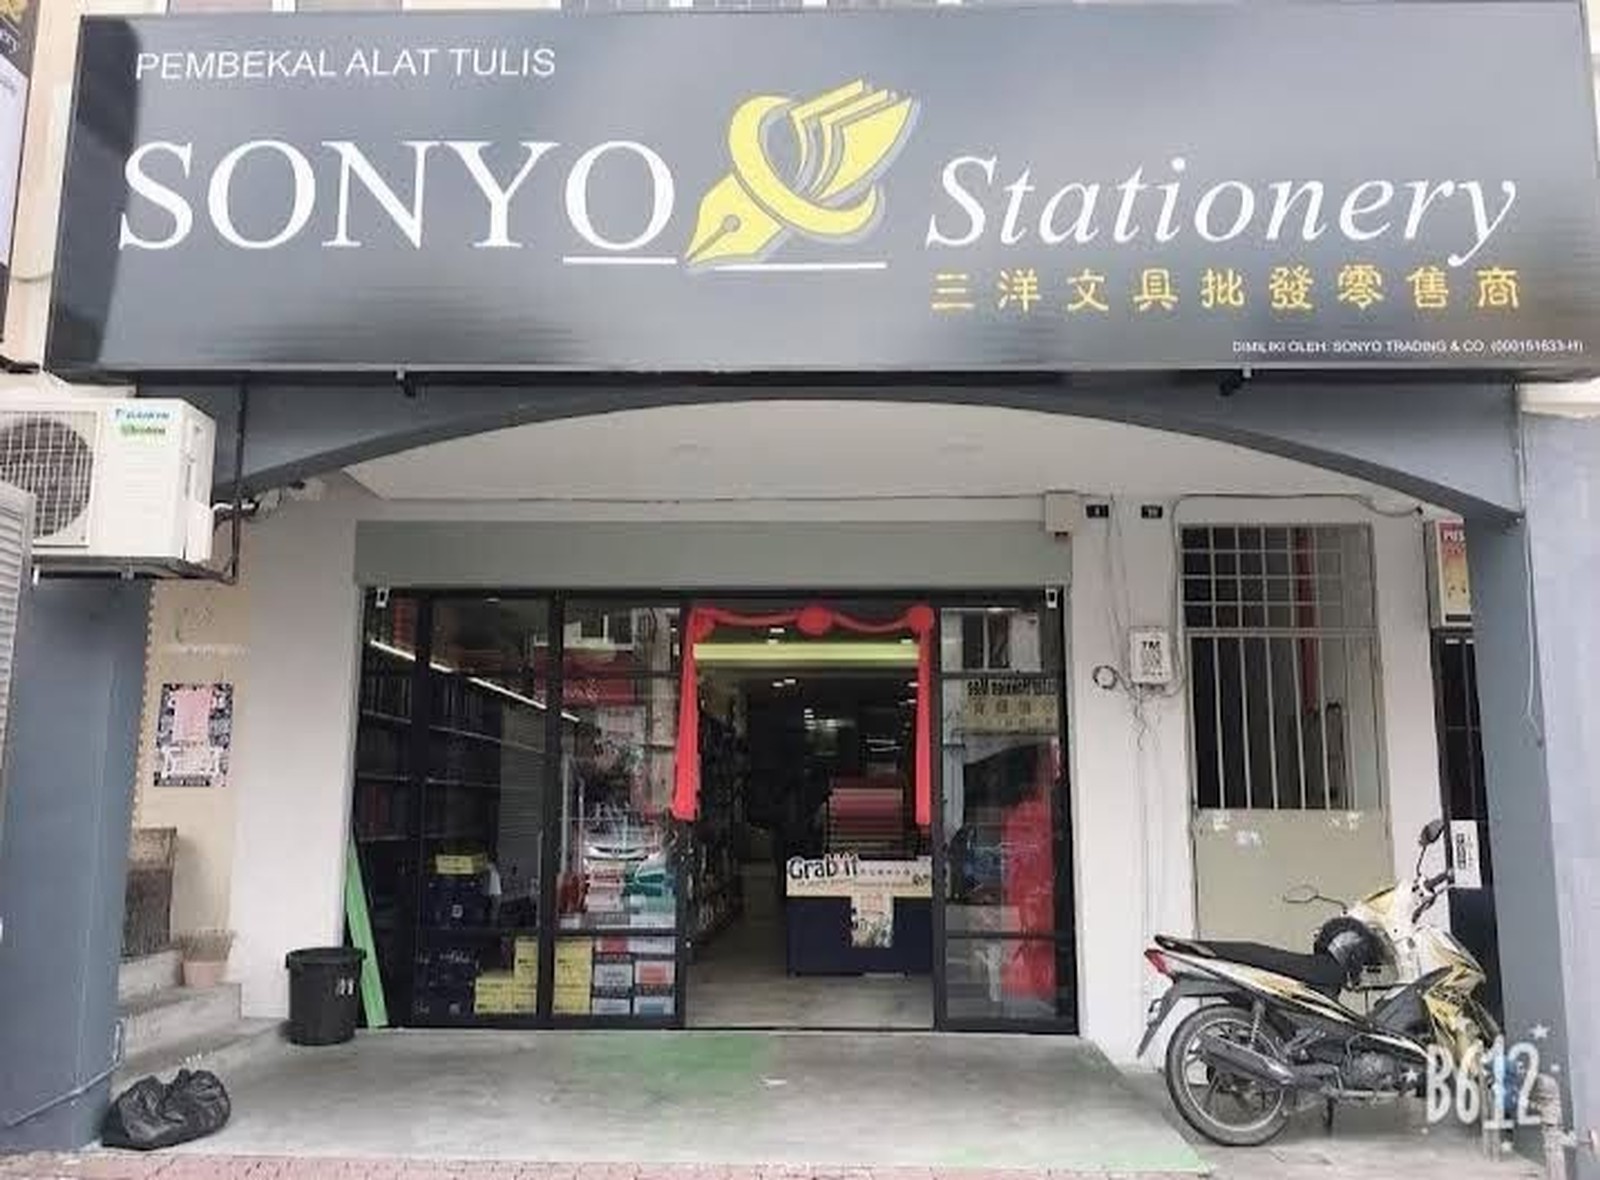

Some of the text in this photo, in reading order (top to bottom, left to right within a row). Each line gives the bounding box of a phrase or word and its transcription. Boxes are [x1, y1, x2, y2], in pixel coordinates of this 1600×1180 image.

[135, 46, 556, 81] PEMBEKAL ALAT TULIS
[119, 139, 677, 252] SONYO
[925, 154, 1518, 268] Stationery
[930, 264, 1522, 313] 三洋文具批發零售商
[1332, 339, 1382, 352] SONYO
[1386, 339, 1447, 352] TRADING
[1450, 339, 1460, 351] &
[788, 855, 838, 880] Grab
